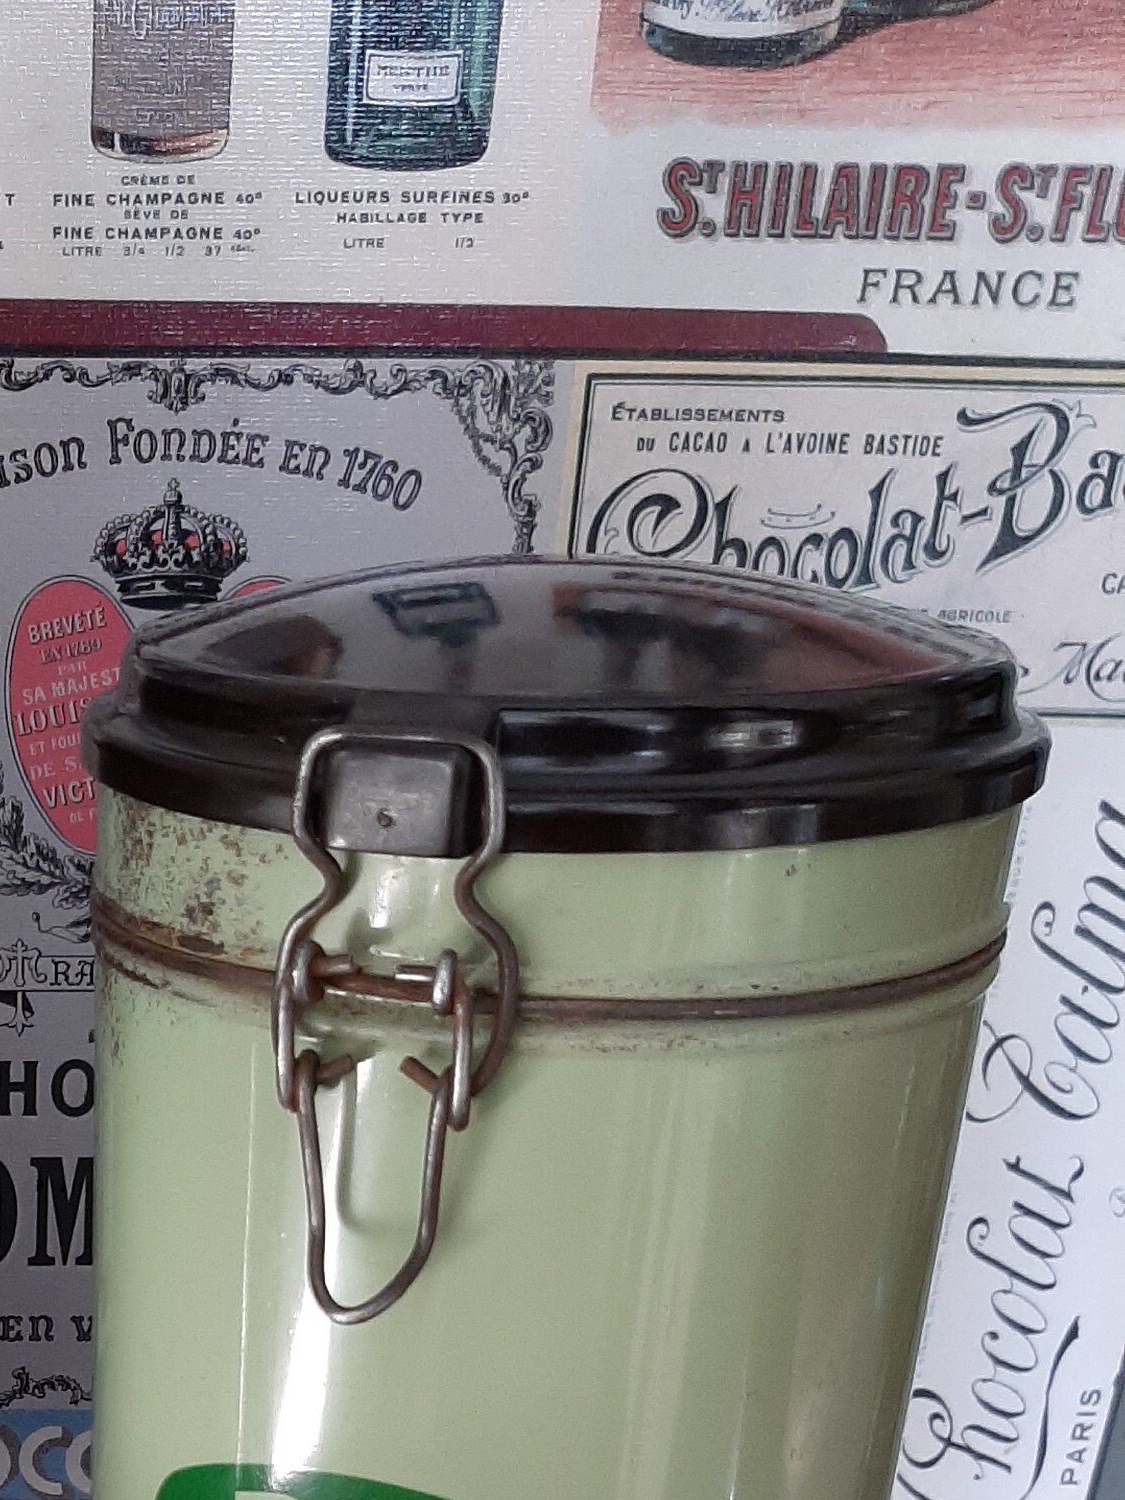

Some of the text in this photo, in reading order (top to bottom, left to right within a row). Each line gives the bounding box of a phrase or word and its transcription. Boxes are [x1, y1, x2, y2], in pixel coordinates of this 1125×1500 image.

[176, 174, 196, 186] DE
[51, 193, 96, 208] FINE
[105, 191, 226, 207] CHAMPAGNE
[294, 190, 391, 205] LIQUEURS
[400, 190, 496, 204] SURFINES
[336, 212, 485, 224] HABILLAGE TYPE
[51, 226, 95, 240] FINE
[104, 226, 224, 241] CHAMPAGNE
[61, 245, 104, 257] LITRE
[164, 244, 185, 257] 1/2
[342, 238, 386, 249] LITRE
[856, 268, 1081, 308] FRANCE
[611, 402, 785, 424] ÉTABLISSEMENTS
[636, 435, 656, 452] DU
[668, 431, 729, 454] CACAO
[765, 430, 850, 455] L'AVOINE
[862, 433, 944, 457] BASTIDE
[105, 416, 266, 468] FONDÉE
[281, 439, 326, 482] EN
[340, 446, 425, 513] 1760
[26, 602, 108, 644] BREVETÉ
[22, 686, 47, 706] SA
[1059, 1387, 1102, 1486] PARIS
